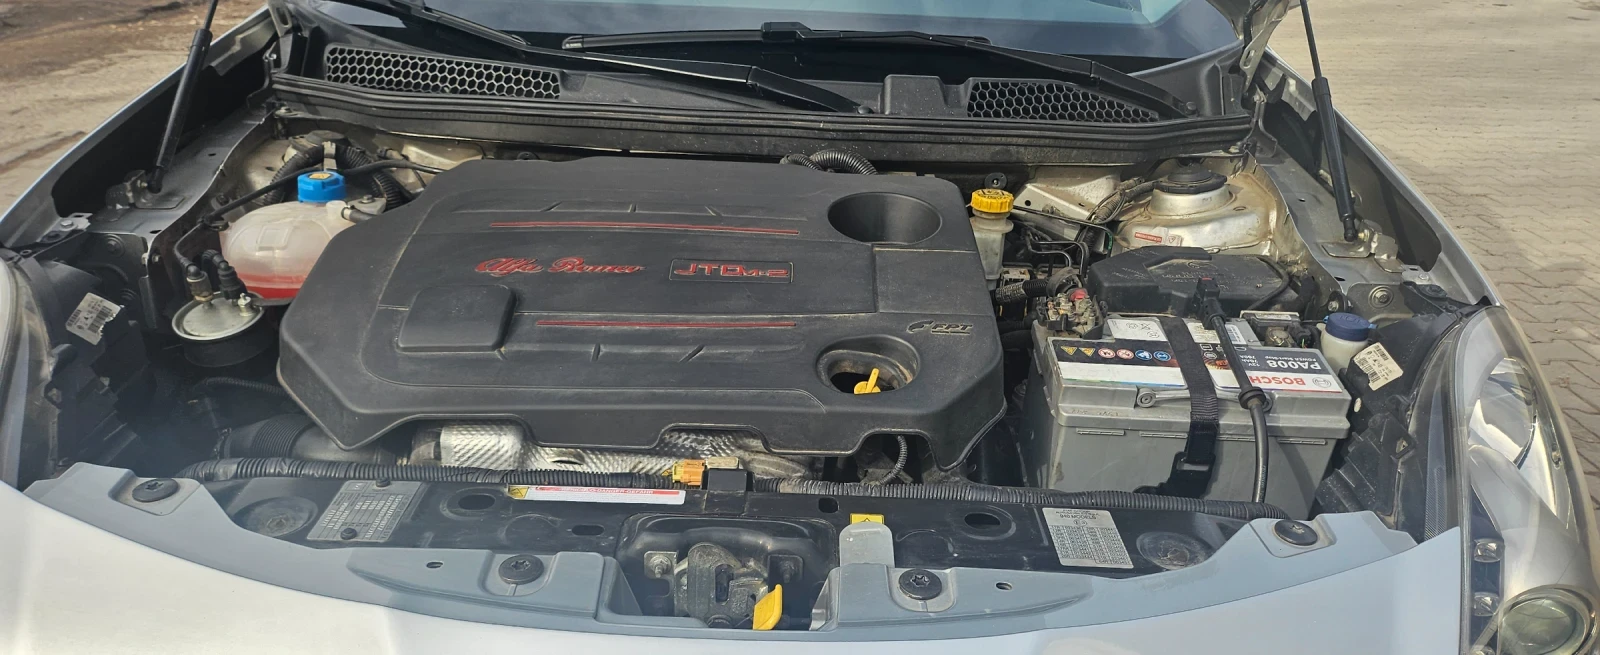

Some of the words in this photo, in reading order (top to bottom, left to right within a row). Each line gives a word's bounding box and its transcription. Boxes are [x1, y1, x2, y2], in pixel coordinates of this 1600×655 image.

[475, 257, 544, 277] Alfa
[548, 256, 645, 273] Romeo
[1266, 360, 1321, 370] PA008
[1249, 376, 1306, 385] BOSCH
